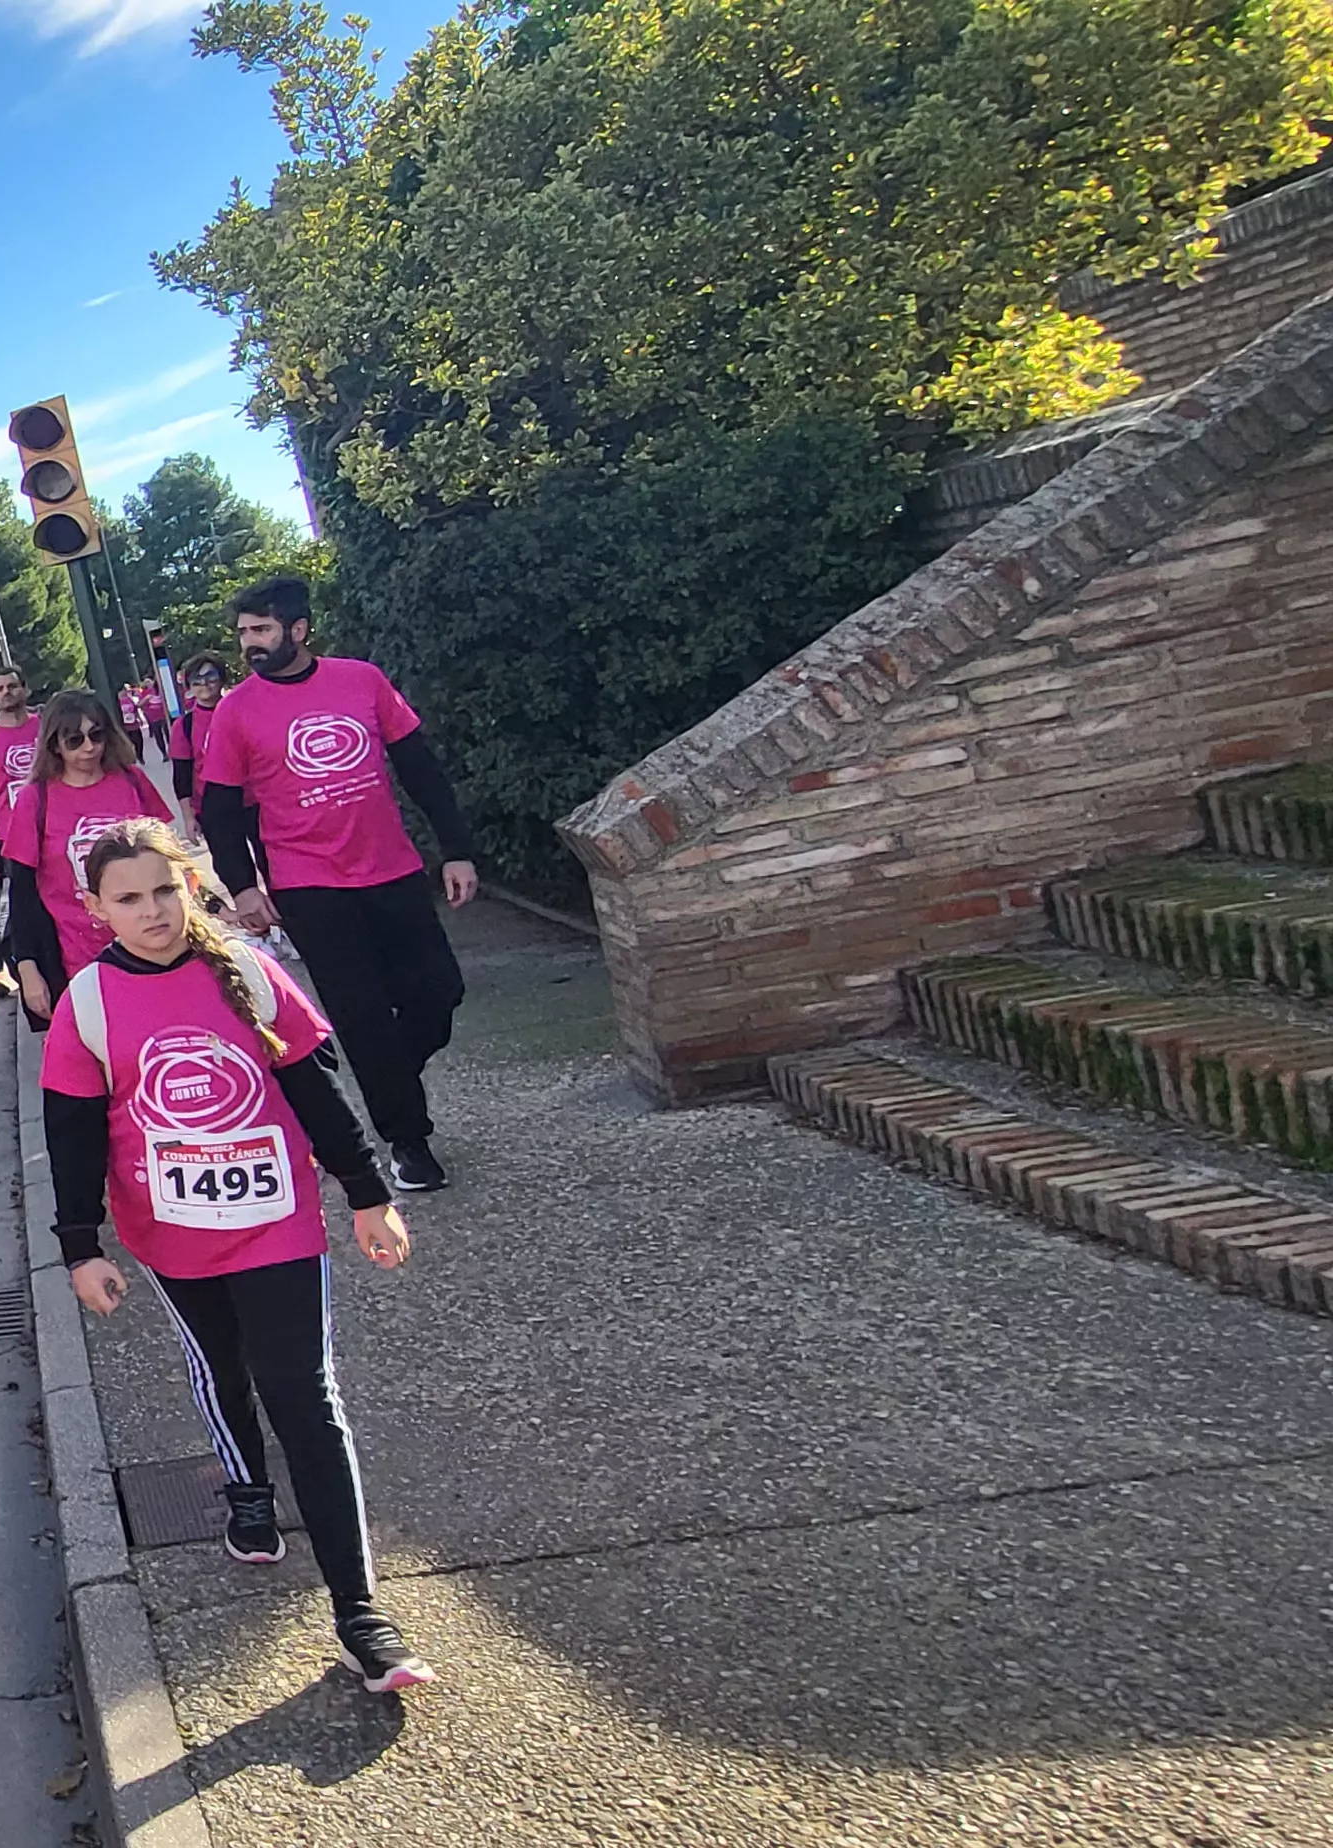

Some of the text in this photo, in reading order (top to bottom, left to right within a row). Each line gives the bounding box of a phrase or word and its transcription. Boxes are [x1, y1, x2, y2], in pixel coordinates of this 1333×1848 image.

[170, 1085, 211, 1101] JUNTOS
[163, 1151, 210, 1163] CONTRA
[213, 1152, 227, 1163] EL
[164, 1162, 279, 1202] 1495
